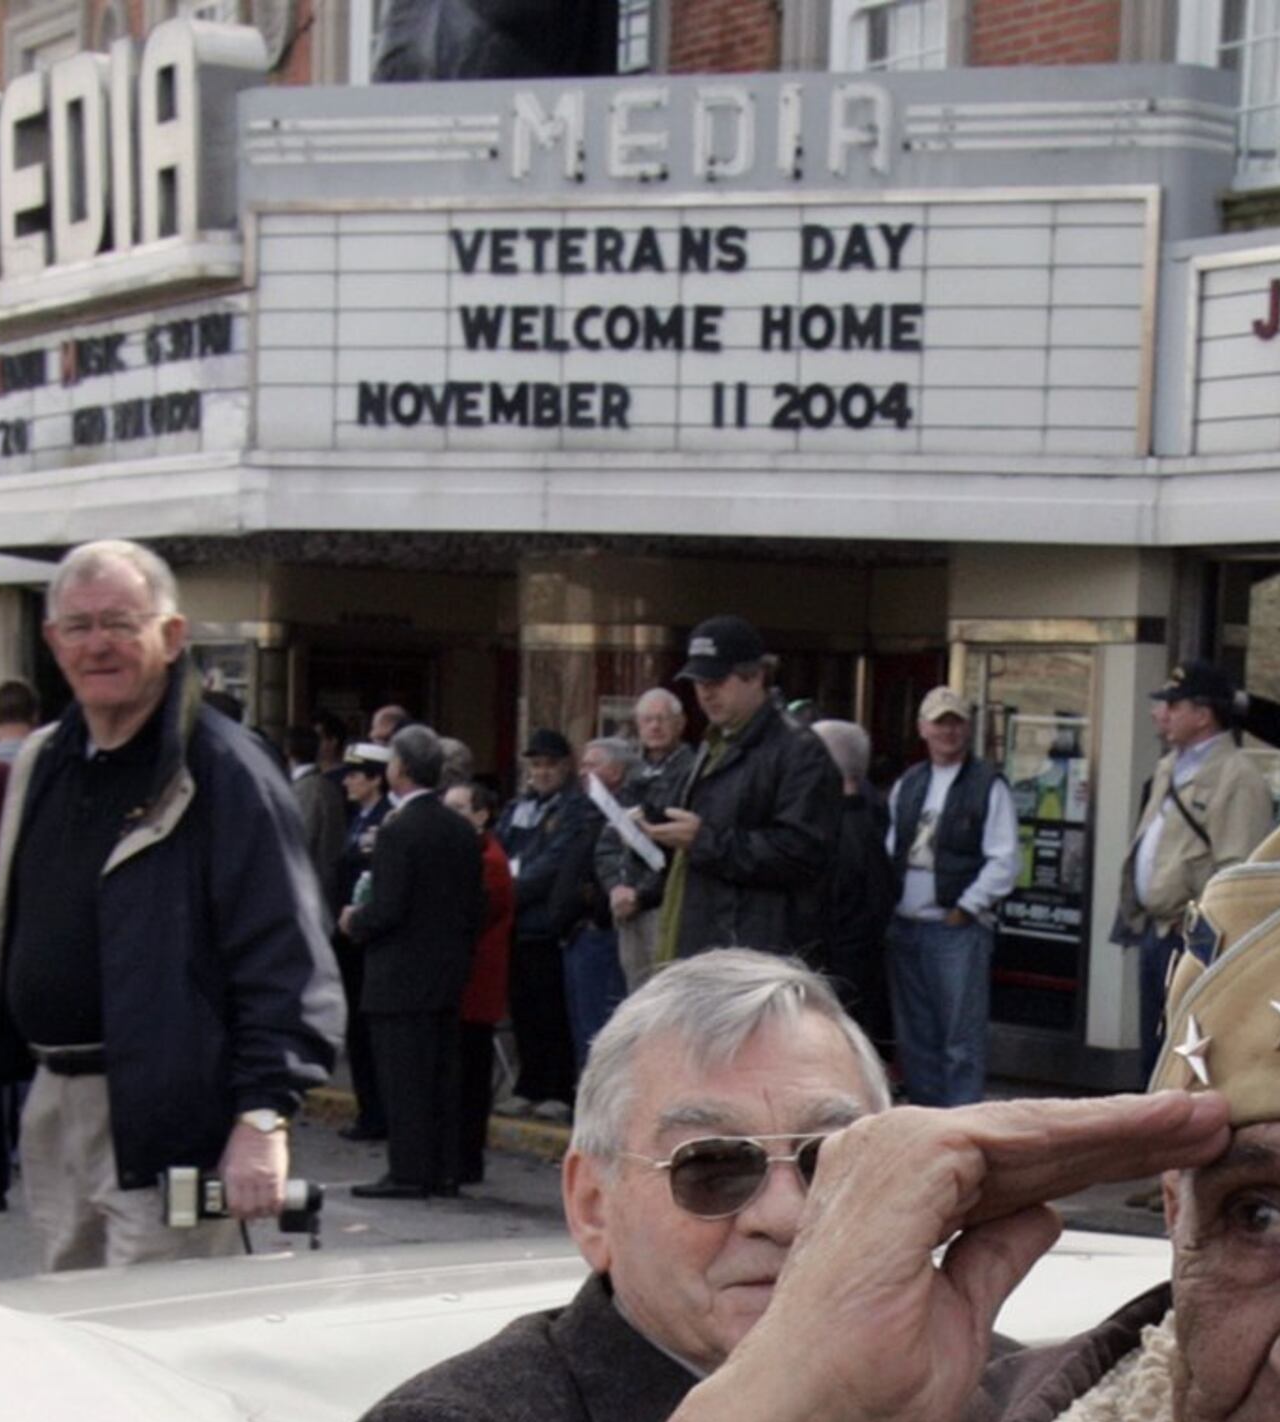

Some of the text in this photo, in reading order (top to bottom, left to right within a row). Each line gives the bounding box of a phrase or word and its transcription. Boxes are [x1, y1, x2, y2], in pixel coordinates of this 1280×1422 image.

[509, 84, 894, 182] MEDIA
[450, 223, 914, 275] VETERANS DAY
[459, 303, 923, 352] WELCOME HOME
[356, 382, 631, 428] NOVEMBER
[773, 382, 913, 429] 2004
